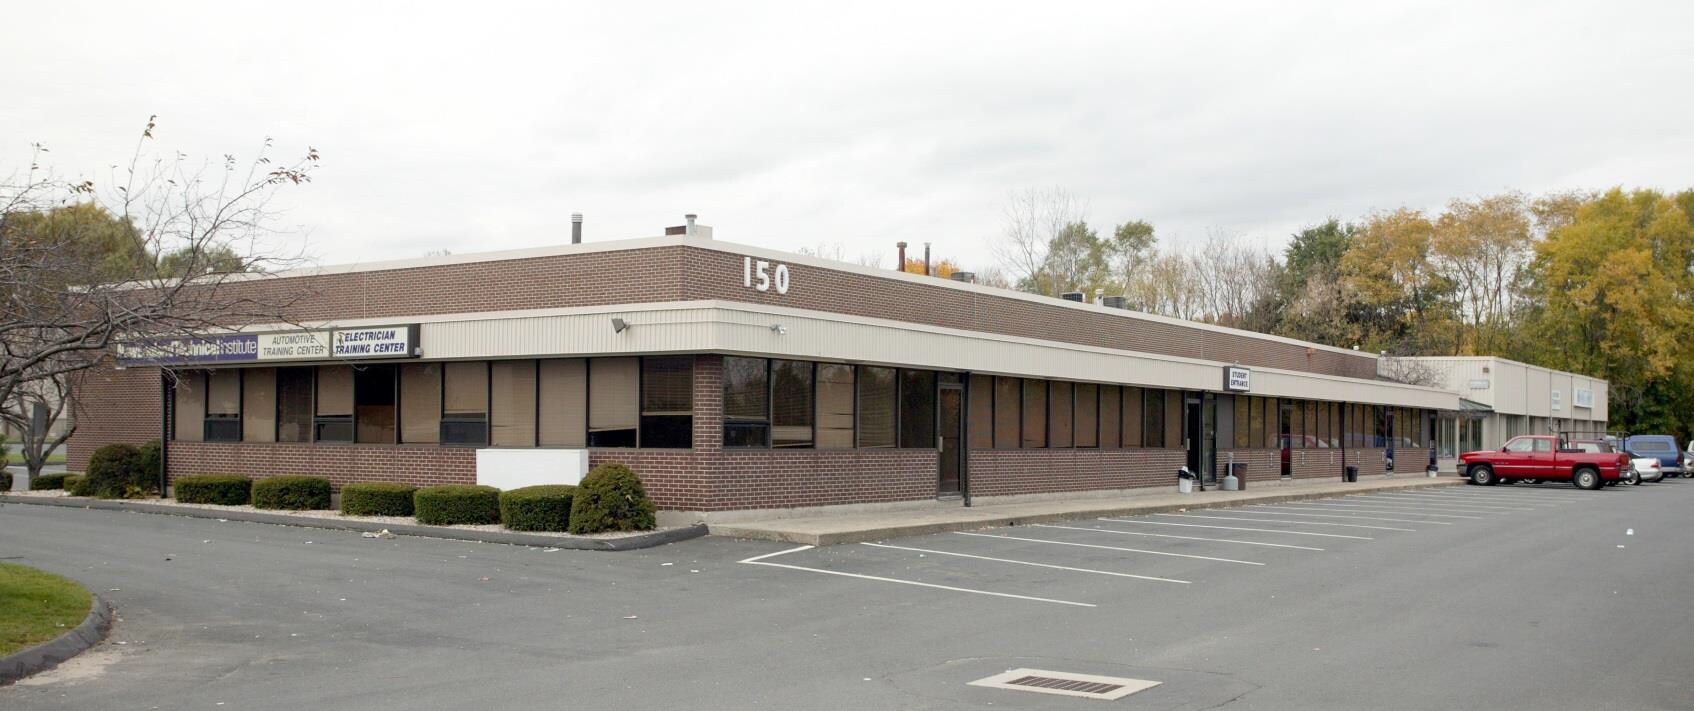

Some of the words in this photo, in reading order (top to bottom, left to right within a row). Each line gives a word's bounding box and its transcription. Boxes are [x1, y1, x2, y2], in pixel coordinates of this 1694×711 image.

[743, 256, 789, 294] 150
[272, 334, 315, 345] AUTOMOTIVE
[344, 330, 395, 342] ELECTRICIAN
[173, 340, 220, 357] Thnical
[263, 346, 293, 356] TRAINING
[296, 345, 324, 355] CENTER
[335, 344, 370, 355] TRAINING
[373, 342, 405, 353] CENTER
[1231, 379, 1248, 388] ENTRANCE
